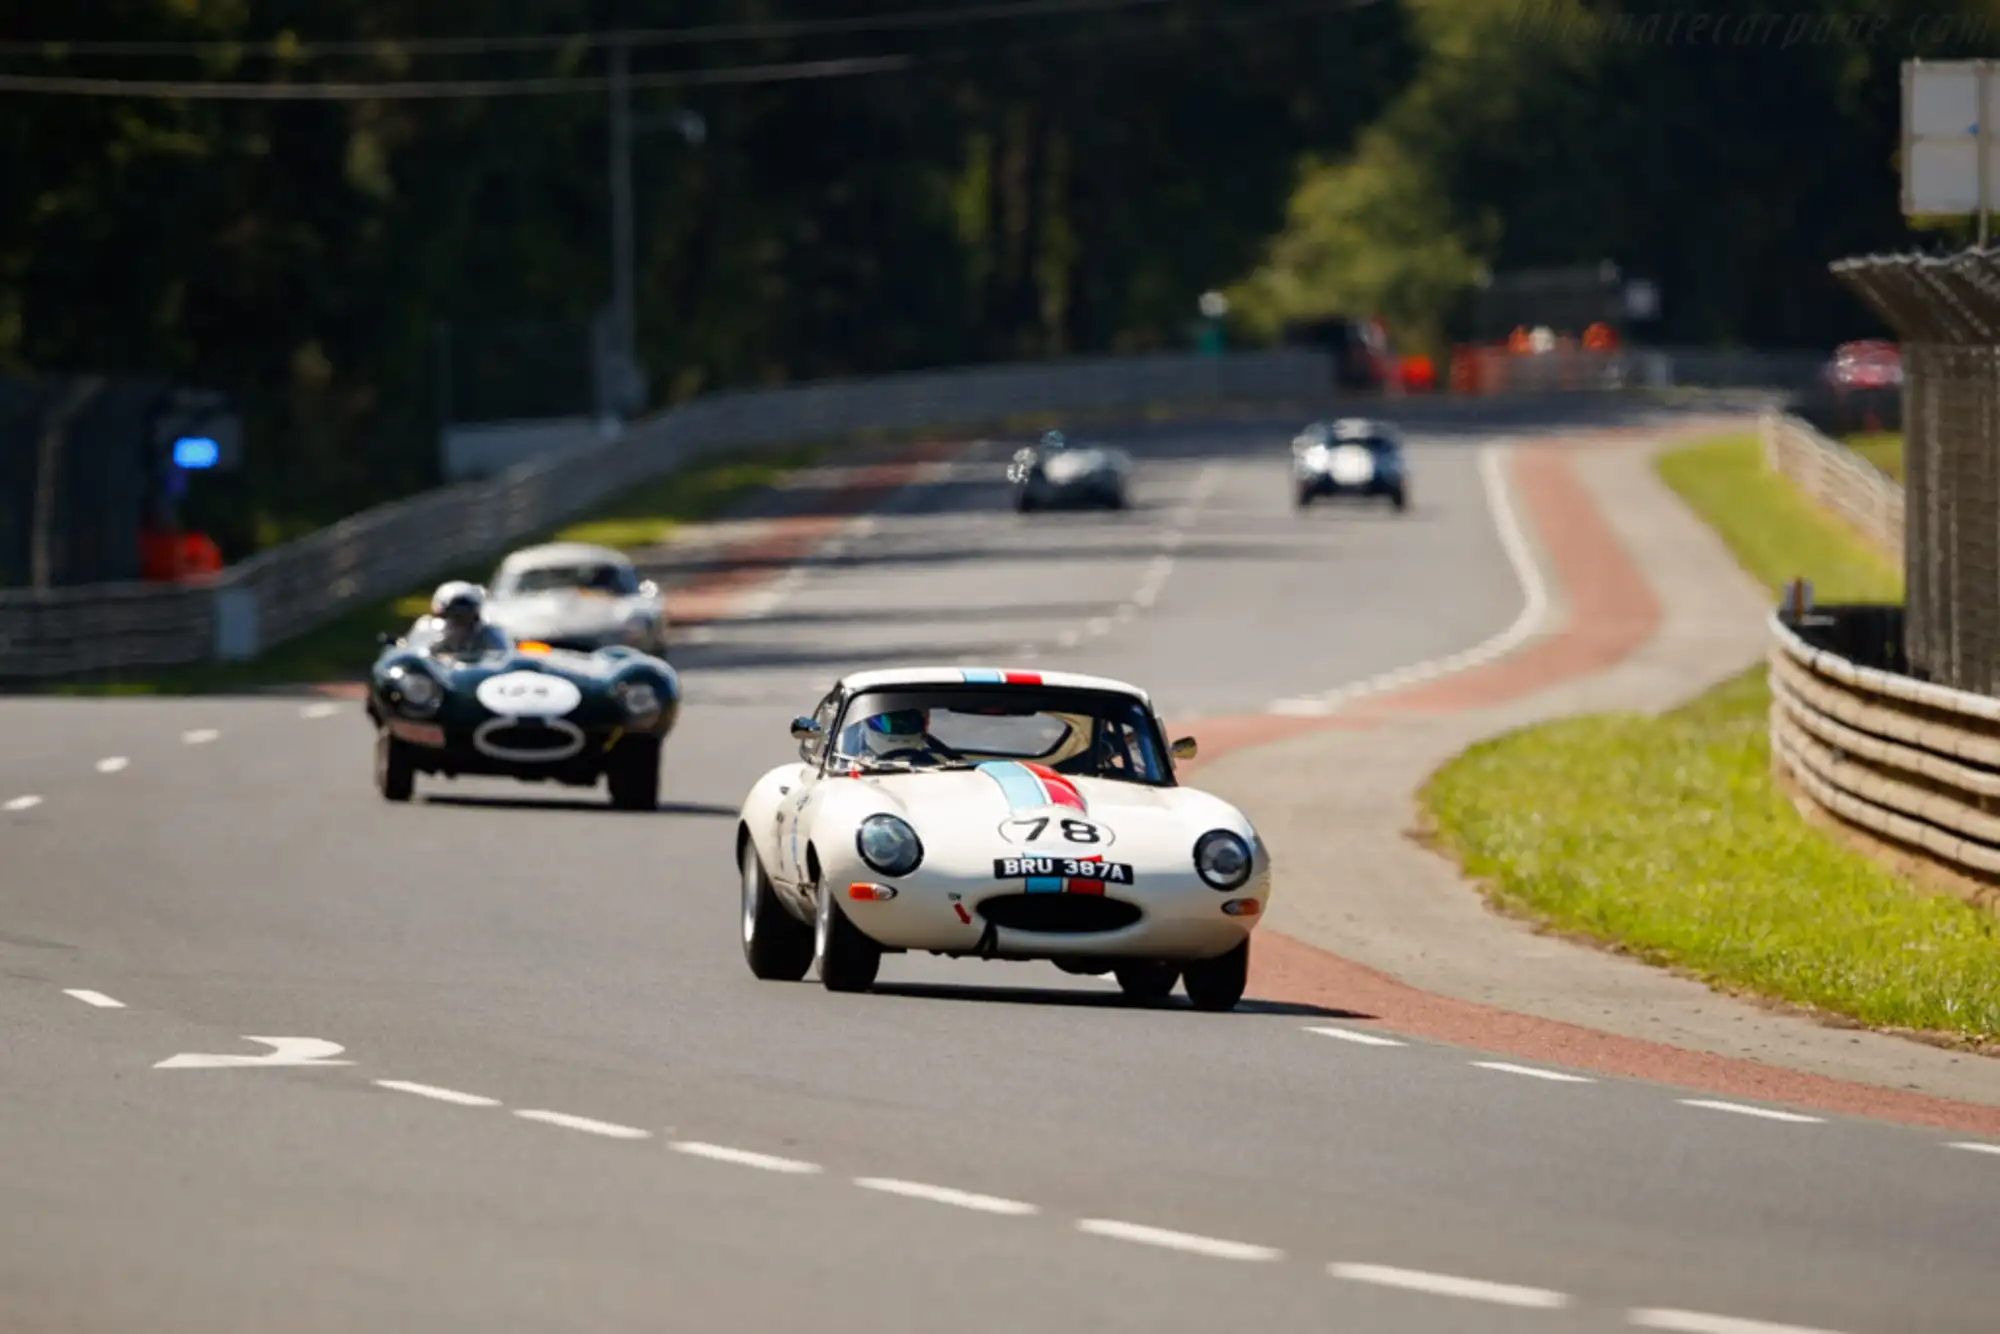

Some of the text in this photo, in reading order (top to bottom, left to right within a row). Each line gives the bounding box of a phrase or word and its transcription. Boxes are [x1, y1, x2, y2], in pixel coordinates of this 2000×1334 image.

[1012, 816, 1101, 844] 78
[1003, 857, 1125, 882] BRU 387A
